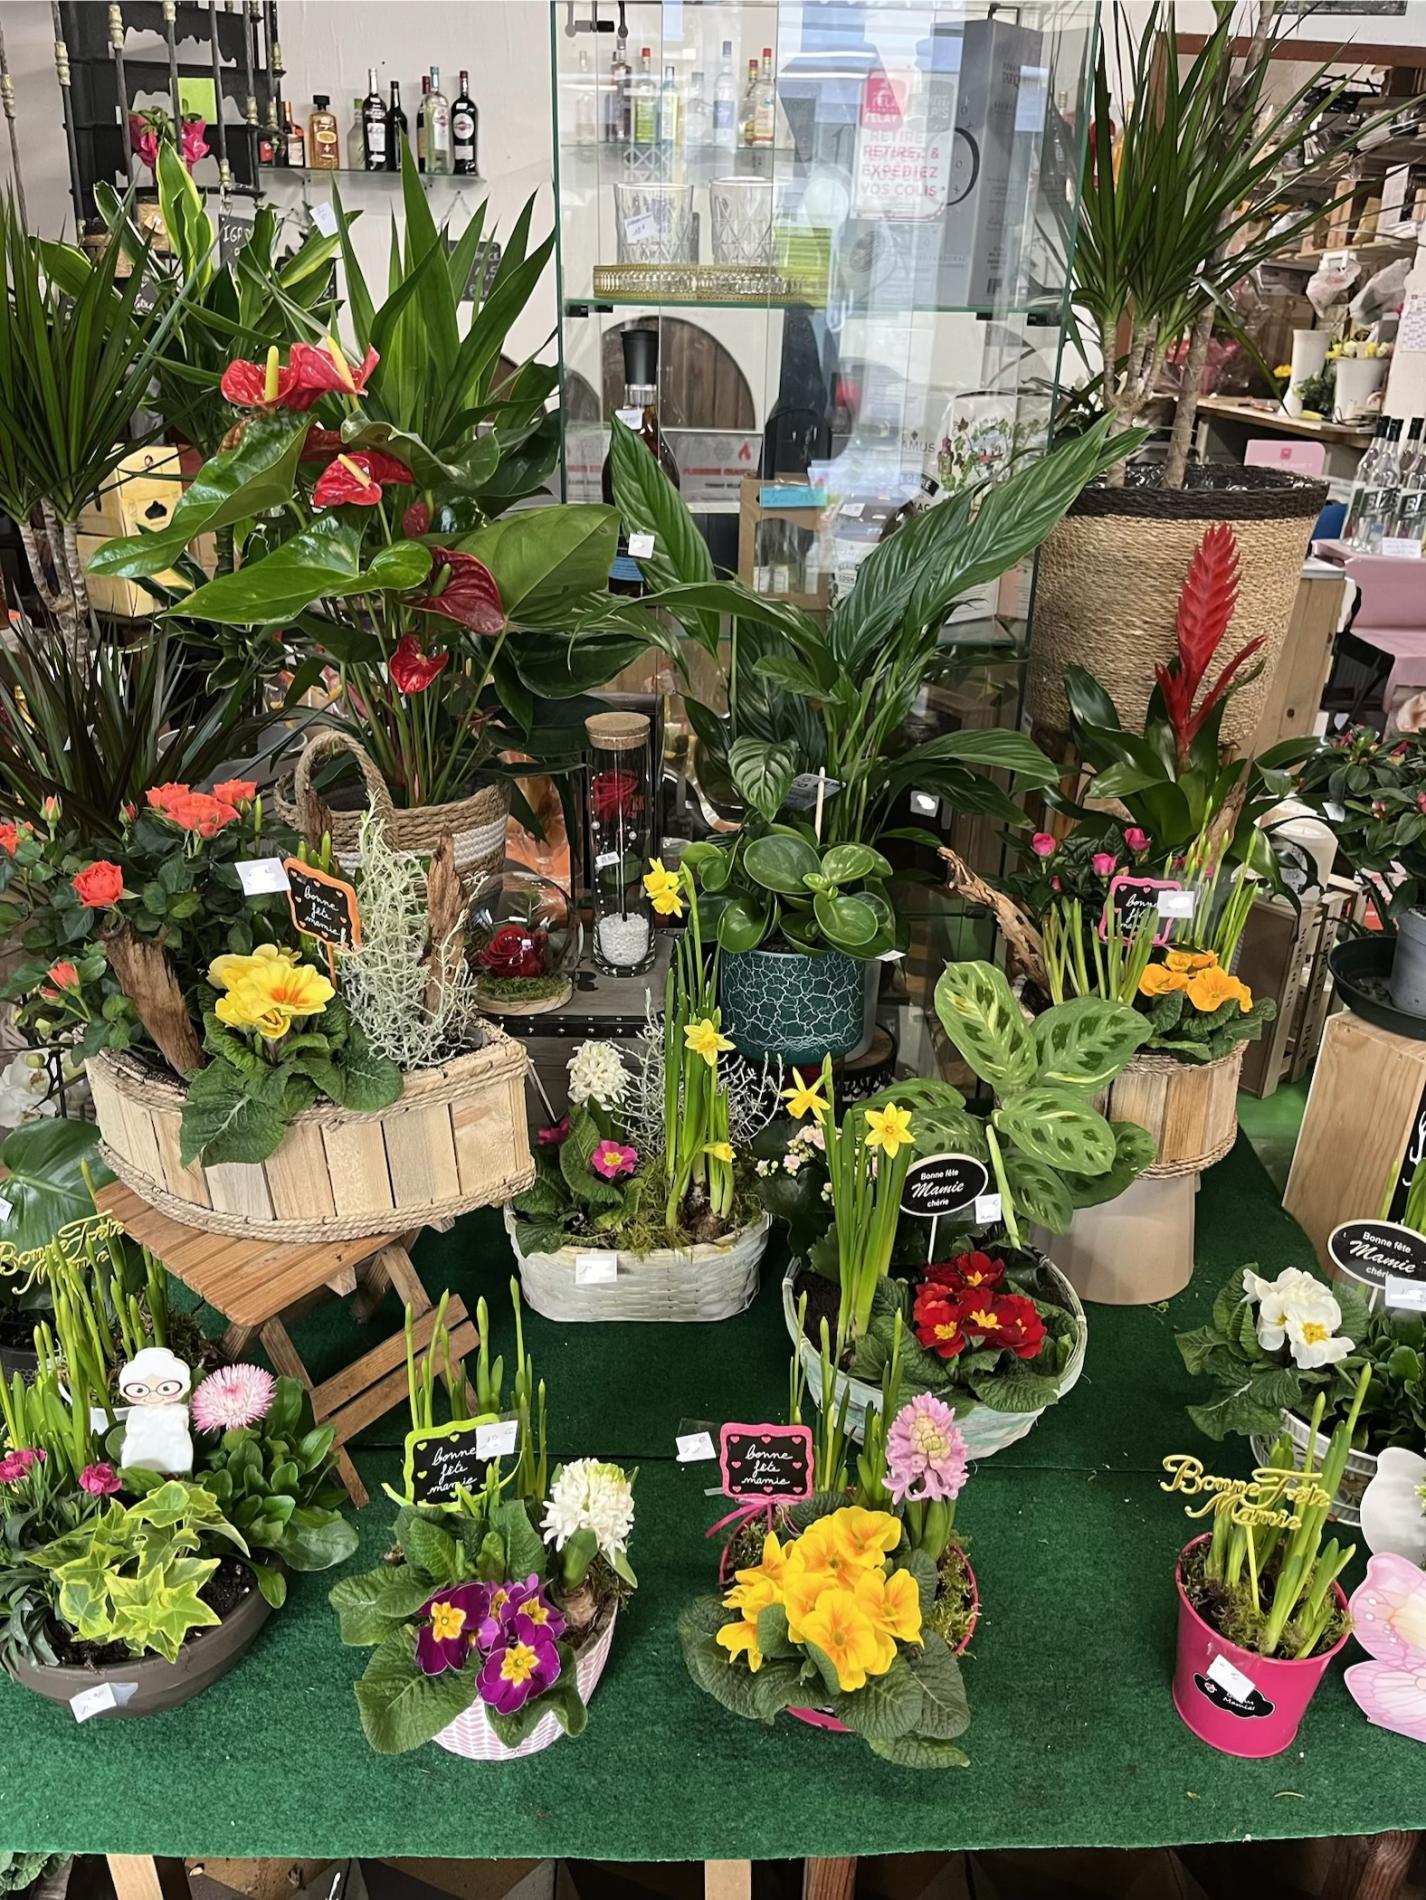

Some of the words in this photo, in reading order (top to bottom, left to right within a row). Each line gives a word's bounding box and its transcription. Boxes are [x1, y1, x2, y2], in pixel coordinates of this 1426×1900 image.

[930, 147, 940, 160] &
[303, 884, 340, 912] bonne
[304, 915, 341, 936] mamie
[920, 1171, 944, 1181] Bonne
[945, 1168, 959, 1177] fête
[911, 1180, 965, 1199] Mamie
[926, 1198, 950, 1208] chérie
[1362, 1231, 1393, 1248] Bonne
[1393, 1240, 1412, 1255] fête
[1349, 1240, 1416, 1274] Mamie
[431, 1446, 478, 1467] bonne
[744, 1443, 794, 1460] bonne
[438, 1460, 469, 1485] fête
[751, 1459, 781, 1478] fête
[1159, 1454, 1262, 1496] Bonne
[740, 1476, 791, 1486] mamie
[1184, 1491, 1303, 1531] Mamie
